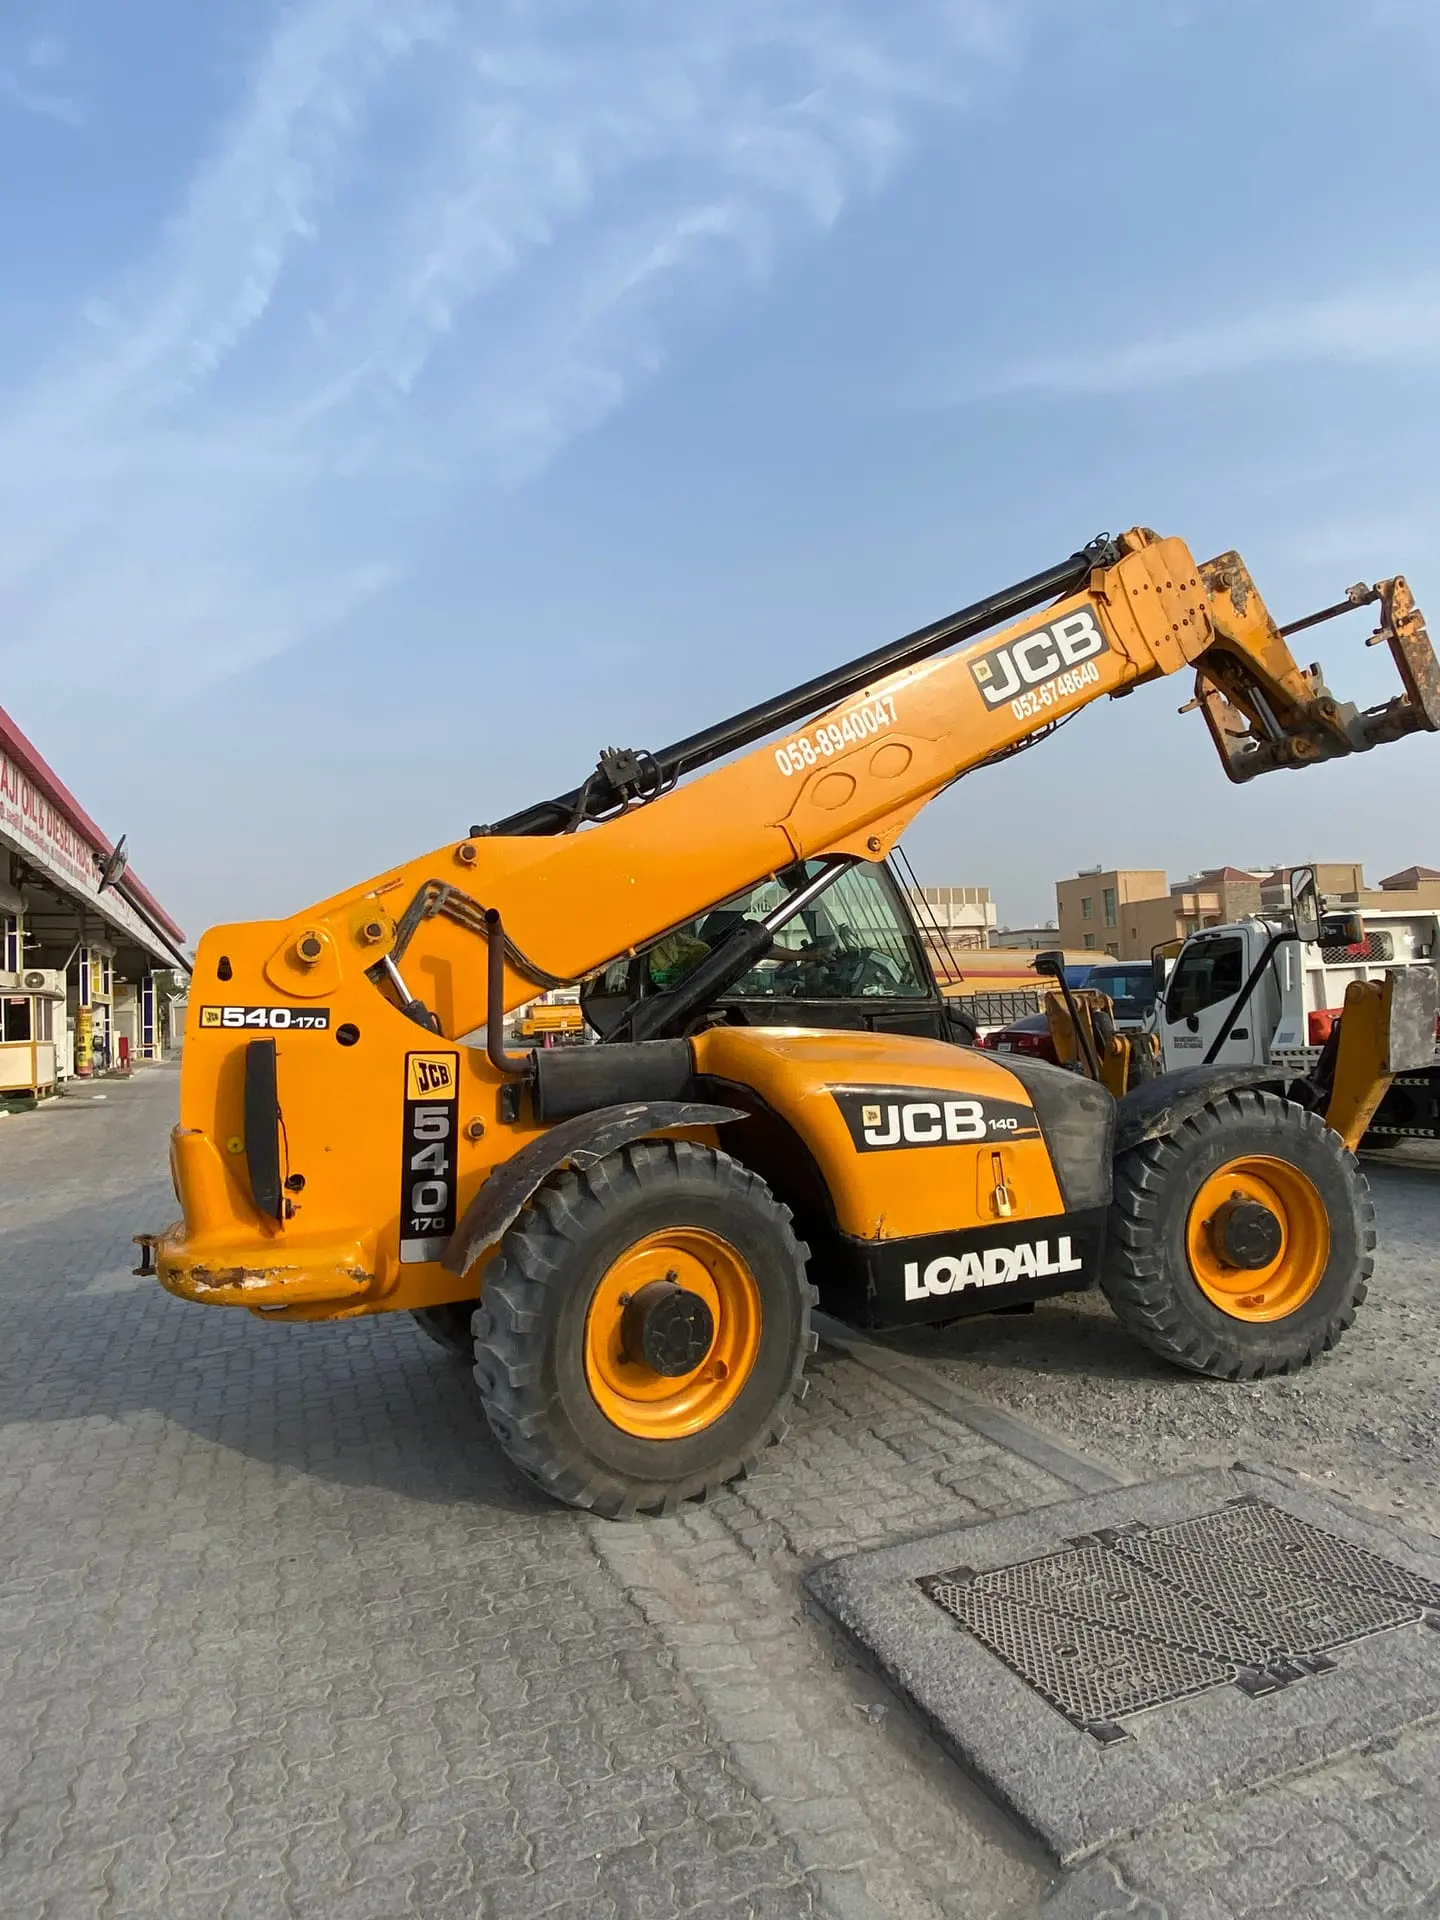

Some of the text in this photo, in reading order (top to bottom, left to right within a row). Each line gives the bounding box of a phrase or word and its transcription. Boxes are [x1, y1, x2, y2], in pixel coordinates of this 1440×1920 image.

[981, 611, 1102, 704] JCB
[1012, 662, 1099, 721] 052-6748640
[774, 696, 898, 777] 058-8940047
[22, 780, 37, 823] OIL
[38, 801, 44, 831] &
[46, 807, 72, 855] DIESEL
[222, 1007, 327, 1028] 540-170
[418, 1061, 450, 1093] JCB
[864, 1101, 986, 1146] JCB
[988, 1118, 1018, 1130] 140
[411, 1217, 446, 1231] 170
[904, 1236, 1082, 1301] LOADALL
